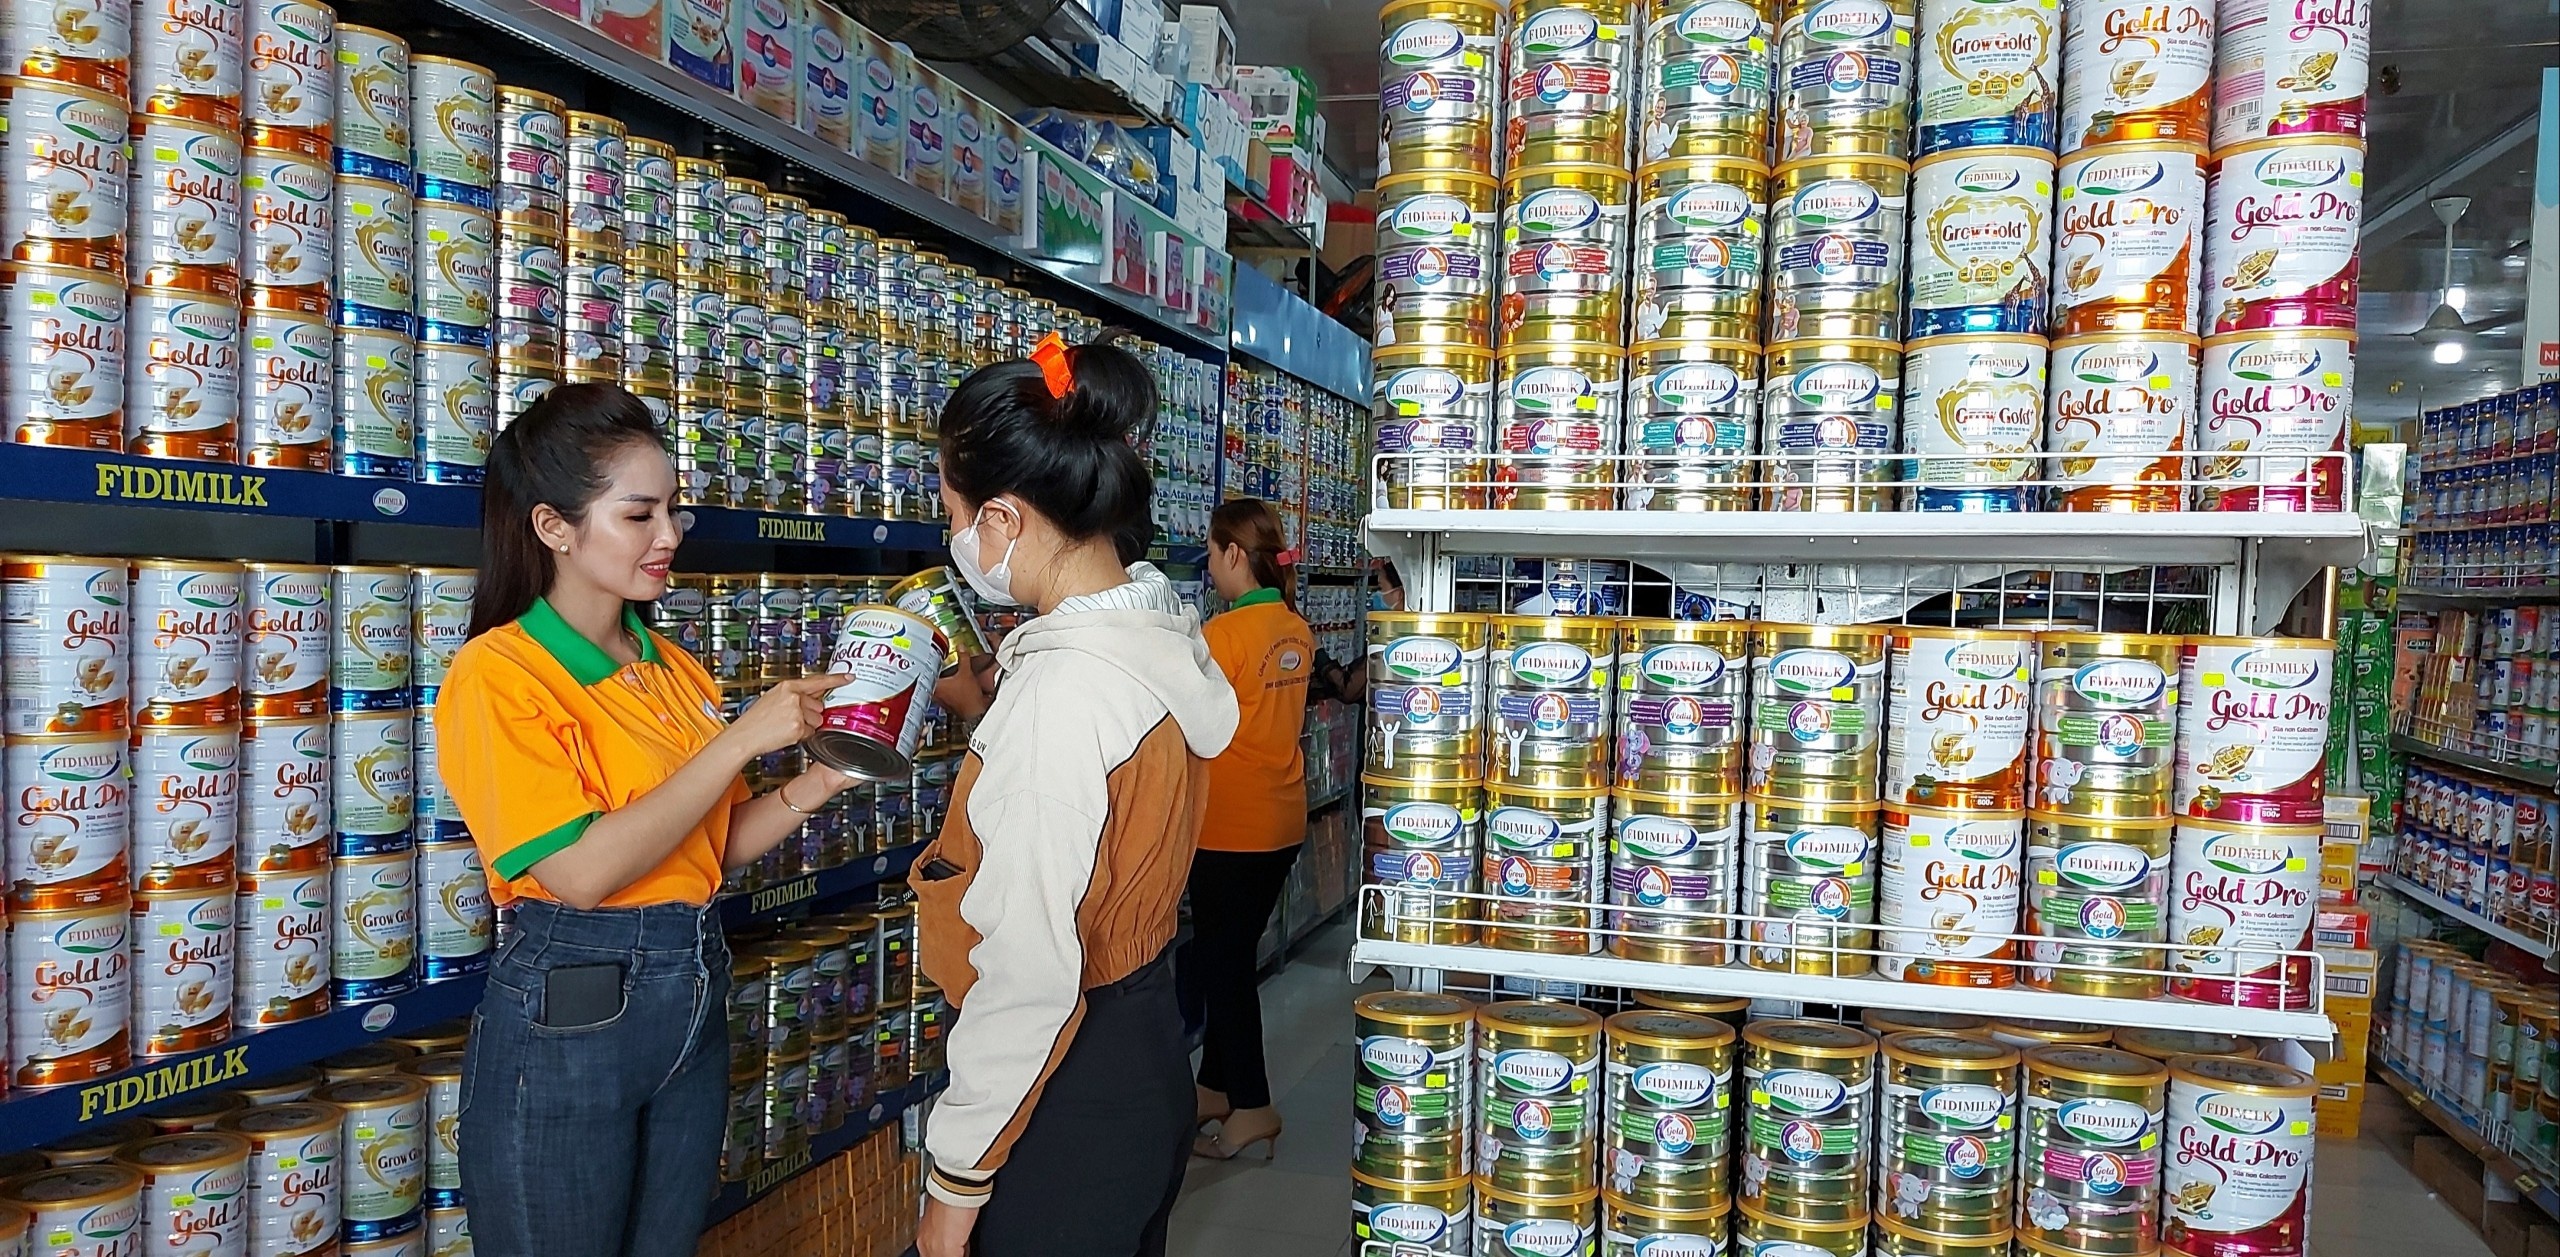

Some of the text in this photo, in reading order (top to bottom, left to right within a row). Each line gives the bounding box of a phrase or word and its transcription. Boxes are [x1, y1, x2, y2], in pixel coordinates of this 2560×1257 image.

[1529, 23, 1587, 42] FIDIMILK
[2100, 6, 2172, 58] Gold
[2289, 0, 2357, 51] Gold
[1952, 38, 1993, 55] Grow
[250, 34, 311, 86] Gold
[27, 135, 103, 192] Gold
[2267, 160, 2336, 176] FIDIMILK
[1963, 171, 2012, 184] FIDIMILK
[2086, 166, 2151, 184] FIDIMILK
[166, 168, 225, 221] Gold
[1529, 204, 1588, 219] FIDIMILK
[1802, 197, 1868, 211] FIDIMILK
[250, 195, 310, 246] Gold
[2061, 200, 2116, 252] Gold
[2231, 192, 2303, 248] Gold
[2155, 284, 2172, 310] 2
[41, 319, 103, 374] Gold
[145, 338, 212, 389] Gold
[266, 357, 318, 404] Gold
[1805, 378, 1870, 393] FIILK
[2054, 387, 2110, 439] Gold
[2208, 386, 2272, 438] Gold
[96, 463, 268, 507] FIDIMILK
[758, 517, 826, 542] FIDIMILK
[63, 609, 120, 657] Gold
[154, 609, 218, 657] Gold
[245, 609, 305, 653] Gold
[362, 624, 391, 640] Grow
[852, 617, 898, 633] FIDIMILK
[1394, 651, 1452, 665] FIDIMILK
[1522, 656, 1581, 671] FIDIMILK
[1653, 659, 1714, 672] FIDIMILK
[1957, 653, 2016, 667] FIDIMILK
[1780, 664, 1843, 679] FIDIMILK
[2245, 661, 2310, 675] FIDIMILK
[2089, 675, 2156, 689] FIDIMILK
[1921, 680, 1986, 733] Gold
[1799, 713, 1818, 725] Gold
[2207, 689, 2279, 744] Gold
[2112, 726, 2133, 738] Gold
[274, 762, 324, 802] Gold
[372, 768, 400, 782] Grow
[156, 775, 219, 819] Gold
[18, 784, 89, 834] Gold
[1396, 815, 1453, 829] FIDIMILK
[1494, 819, 1547, 837] FIDIMILK
[1627, 828, 1685, 845] FIDIMILK
[2214, 844, 2282, 861] FIDIMILK
[2069, 857, 2138, 873] FIDIMILK
[1508, 869, 1525, 880] Grow
[750, 876, 818, 914] FIDIMILK
[1641, 880, 1662, 892] Pedia
[1822, 889, 1841, 901] Gold
[1920, 860, 1987, 912] Gold
[2182, 871, 2246, 928] Gold
[362, 913, 394, 928] Grow
[2092, 909, 2113, 921] Gold
[274, 912, 324, 953] Gold
[165, 936, 220, 979] Gold
[32, 961, 101, 1005] Gold
[1368, 1048, 1422, 1066] FIDIMILK
[1504, 1062, 1562, 1079] FIDIMILK
[79, 1045, 249, 1122] FIDIMILK
[1645, 1076, 1706, 1092] FIDIMILK
[1772, 1082, 1834, 1100] FIDIMILK
[1383, 1097, 1400, 1108] Gold
[1934, 1098, 1999, 1113] FIDIMILK
[1523, 1112, 1541, 1123] Gold
[2073, 1112, 2139, 1129] FIDIMILK
[2206, 1103, 2273, 1122] FIDIMILK
[1666, 1126, 1685, 1137] Gold
[1791, 1133, 1810, 1145] Gold
[377, 1153, 407, 1169] Grow
[1957, 1149, 1976, 1160] Gold
[2176, 1125, 2240, 1186] Gold
[746, 1144, 812, 1200] FIDIMILK
[2095, 1165, 2116, 1177] Gold
[280, 1164, 331, 1208] Gold
[169, 1203, 229, 1247] Gold
[1380, 1216, 1436, 1231] FIDIMILK
[1517, 1232, 1574, 1247] FIDIMILK
